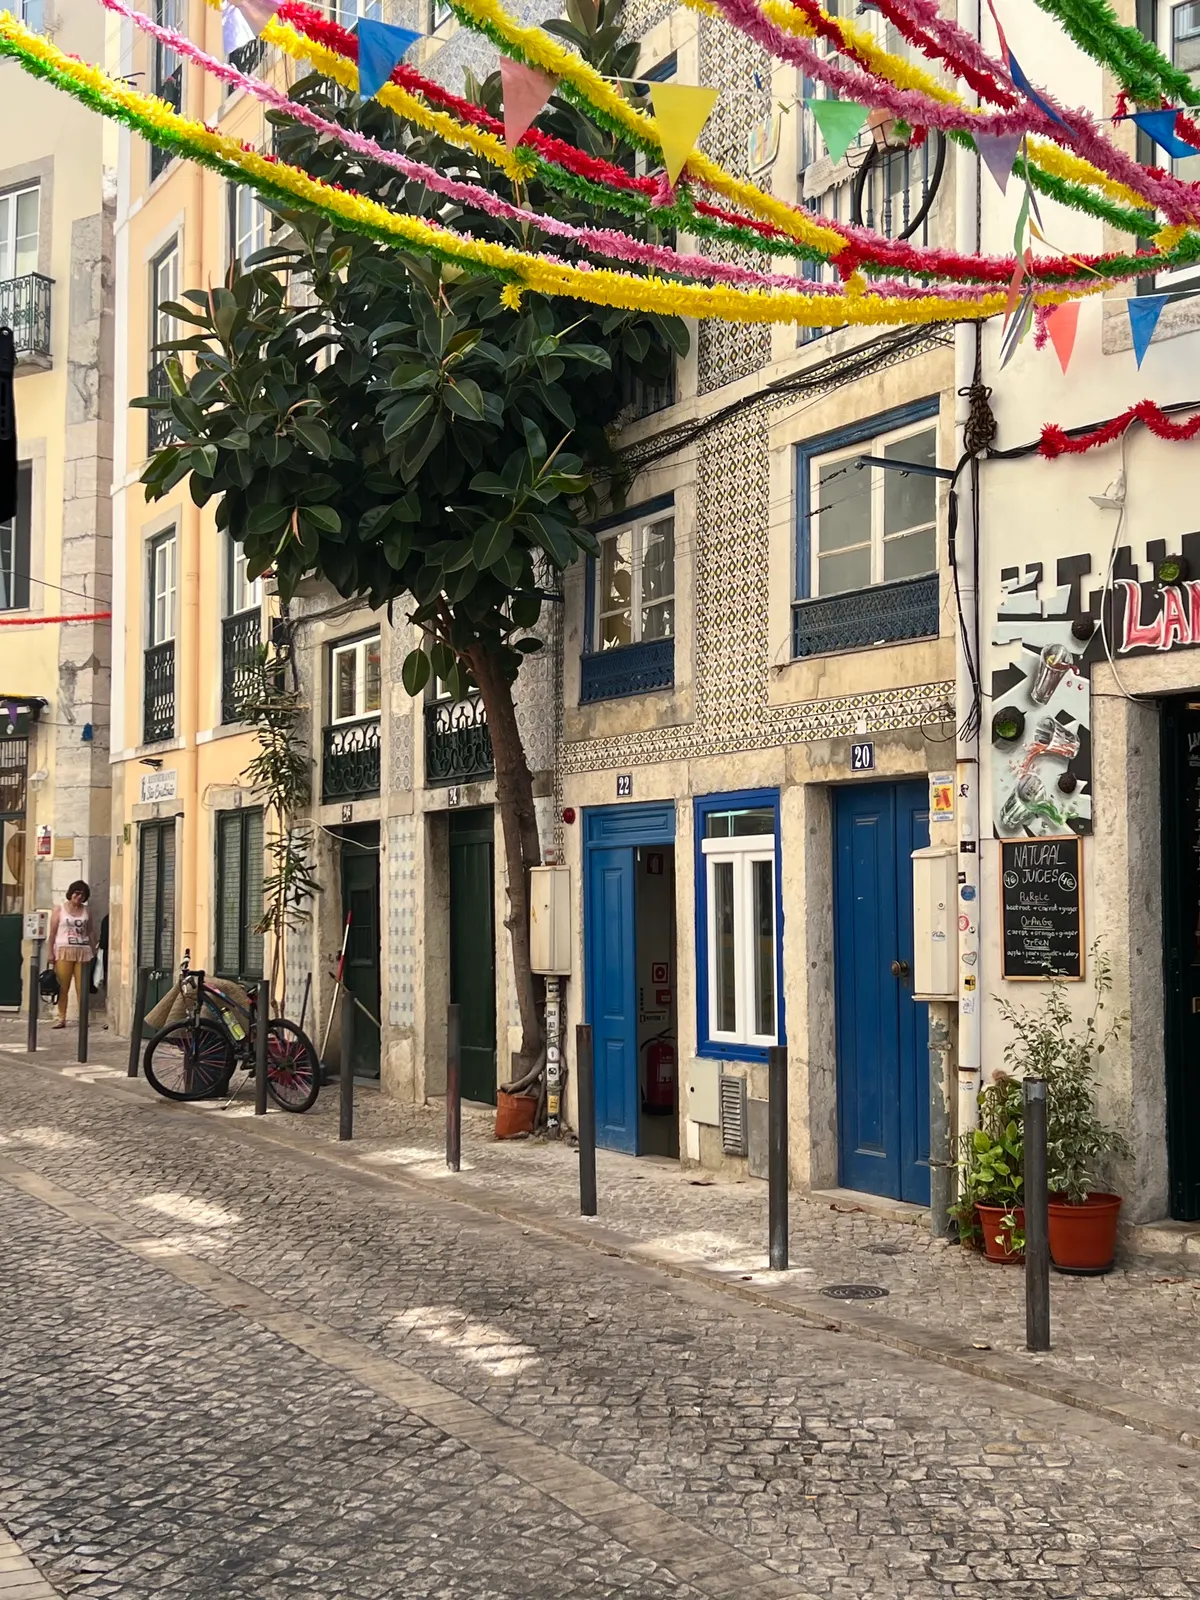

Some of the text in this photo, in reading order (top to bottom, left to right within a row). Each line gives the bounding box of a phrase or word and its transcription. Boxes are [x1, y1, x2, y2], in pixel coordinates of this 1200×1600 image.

[855, 745, 870, 768] 20
[618, 776, 630, 795] 22
[1013, 844, 1067, 868] NATURAL
